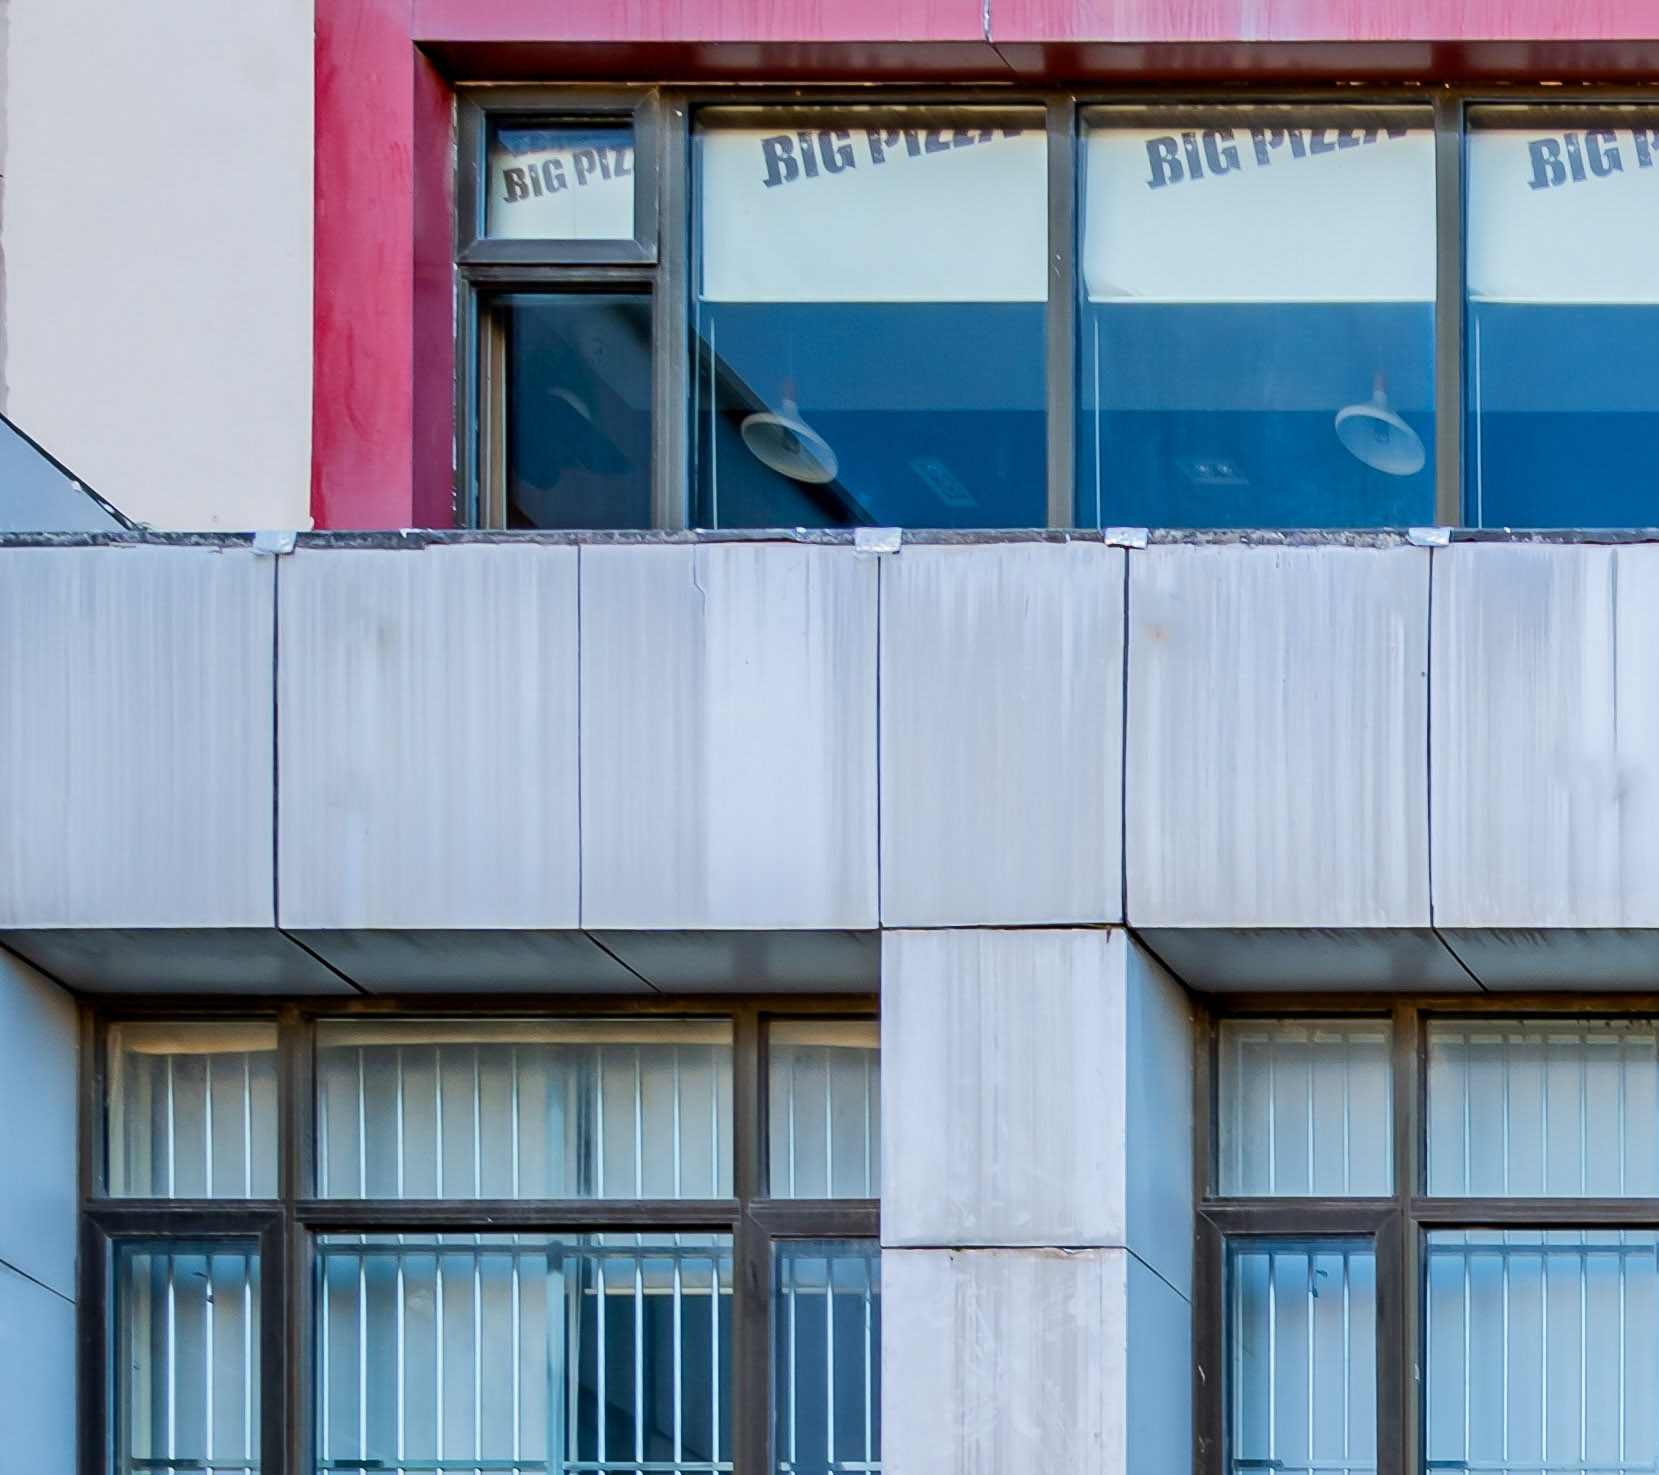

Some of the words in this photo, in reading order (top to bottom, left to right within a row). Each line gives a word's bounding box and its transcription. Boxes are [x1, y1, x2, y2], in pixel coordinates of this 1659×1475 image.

[503, 159, 568, 203] BIG
[761, 130, 856, 187] BIG
[865, 129, 1027, 165] PIZ
[1145, 128, 1242, 190] BIG
[1249, 128, 1407, 166] PIZ
[1527, 129, 1623, 190] BIG
